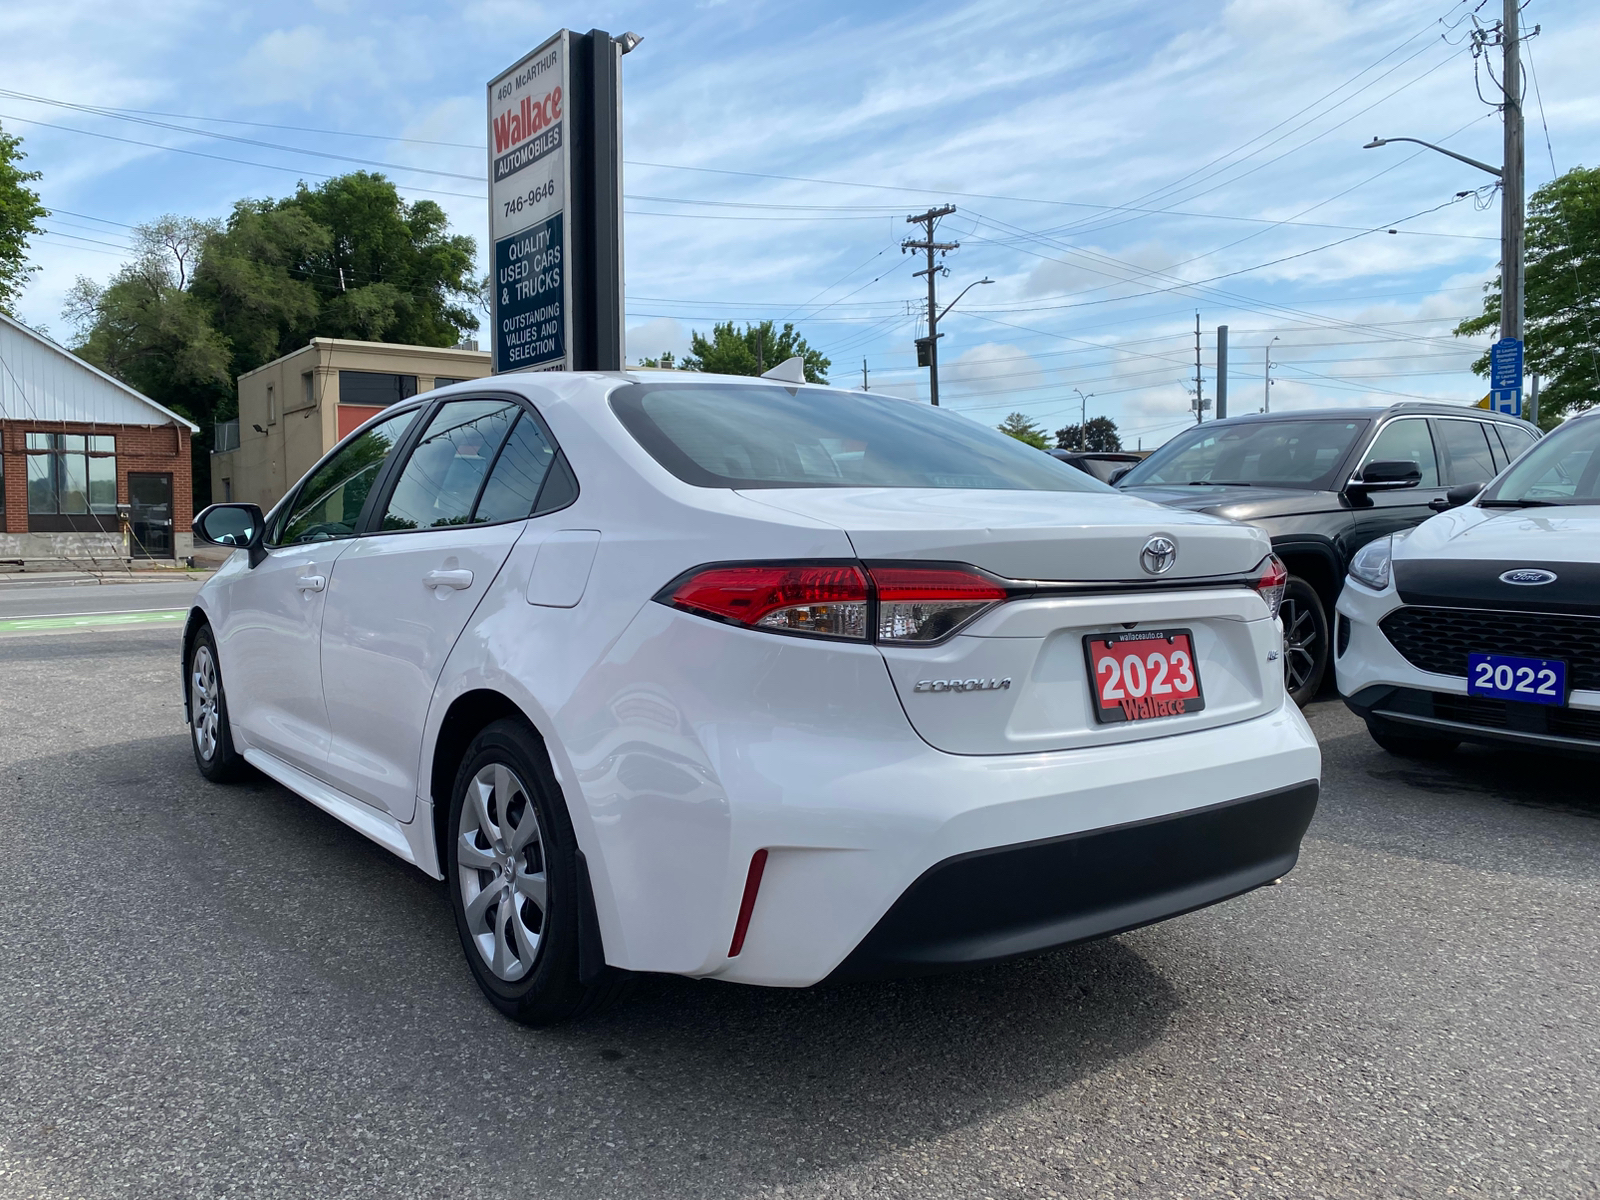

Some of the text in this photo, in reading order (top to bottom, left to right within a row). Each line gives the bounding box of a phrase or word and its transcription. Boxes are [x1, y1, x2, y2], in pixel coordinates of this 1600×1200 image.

[497, 51, 557, 101] 460 McARTHUR
[493, 86, 562, 154] Wallace
[498, 127, 560, 177] AUTOMOBILES
[503, 179, 555, 218] 746-9646
[508, 228, 552, 261] QUALITY
[500, 245, 561, 284] USED CARS
[501, 268, 560, 305] & TRUCKS
[502, 302, 560, 333] OUTSTANDING
[506, 321, 558, 347] VALUES AND
[509, 338, 555, 362] SELECTION
[1495, 390, 1517, 414] H
[1512, 572, 1542, 581] Ford
[1119, 632, 1164, 642] wallaceauto.ca
[913, 677, 1012, 693] COROLLA
[1097, 650, 1195, 700] 2023
[1474, 663, 1557, 696] 2022
[1120, 696, 1186, 721] Wallace
